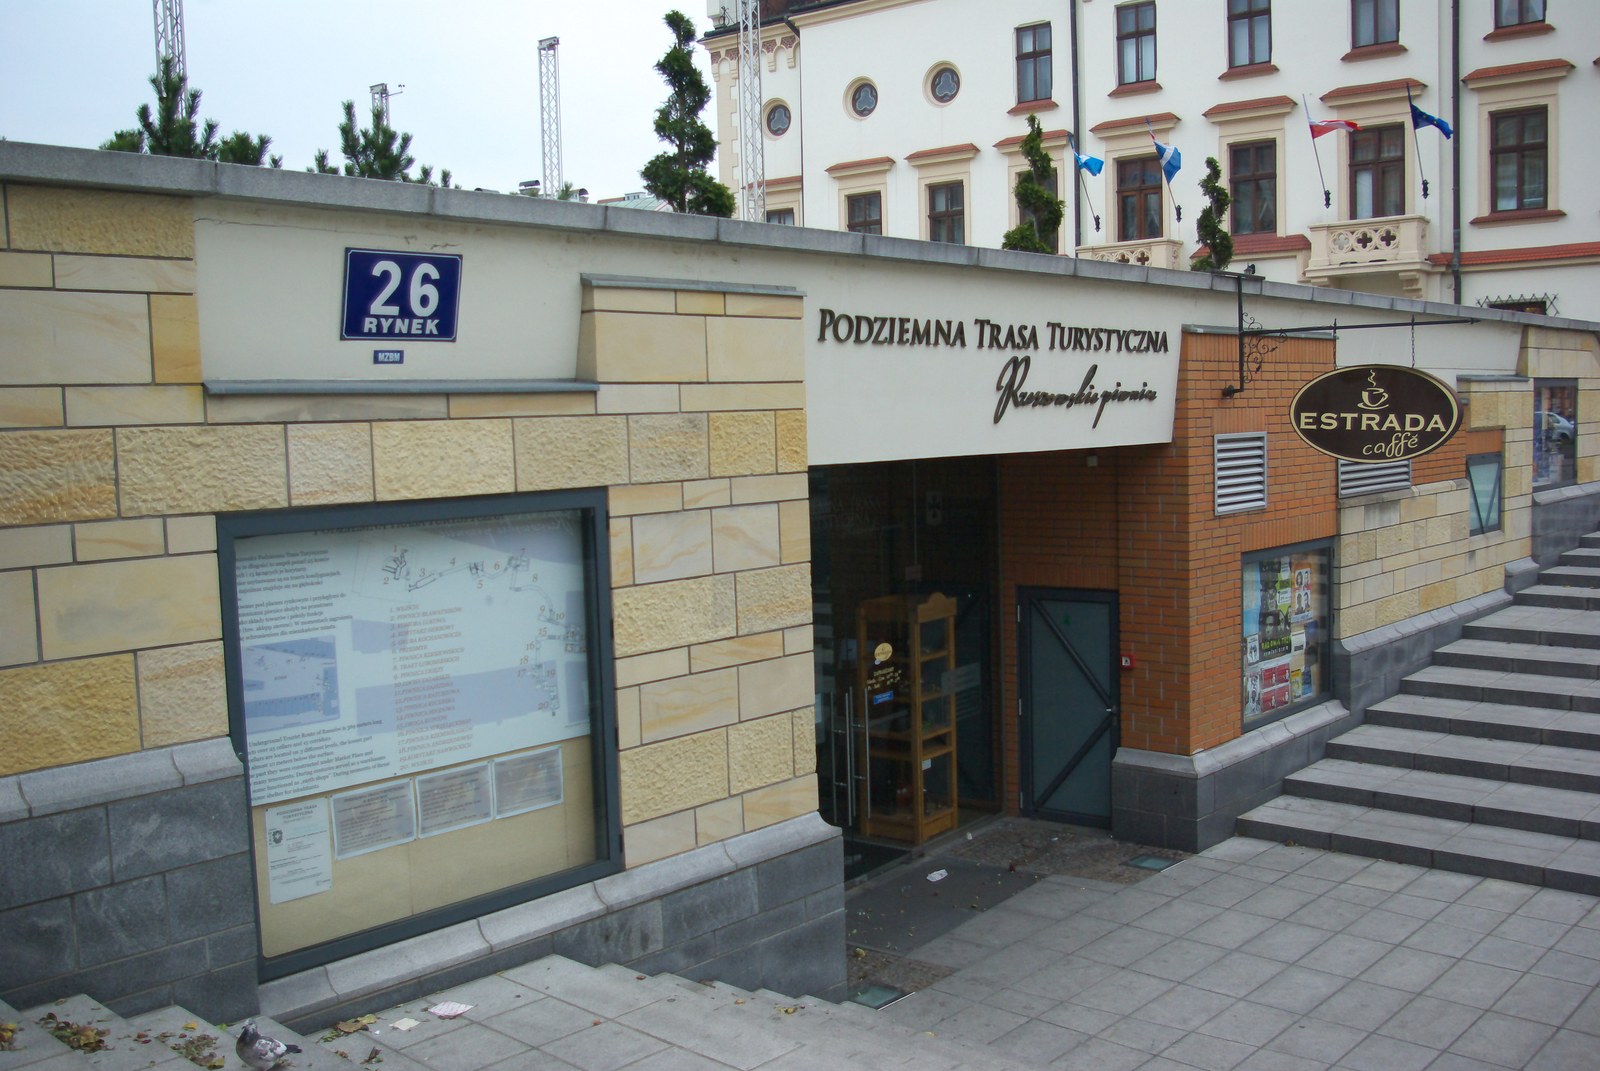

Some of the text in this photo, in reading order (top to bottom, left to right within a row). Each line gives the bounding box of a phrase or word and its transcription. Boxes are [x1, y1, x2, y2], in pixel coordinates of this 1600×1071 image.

[370, 260, 440, 317] 26
[363, 317, 440, 335] RYNEK
[816, 308, 1170, 353] PODZIEMNA TRASA TURYSTYCZNA
[378, 352, 401, 362] MZBM
[1299, 411, 1447, 433] ESTRADA
